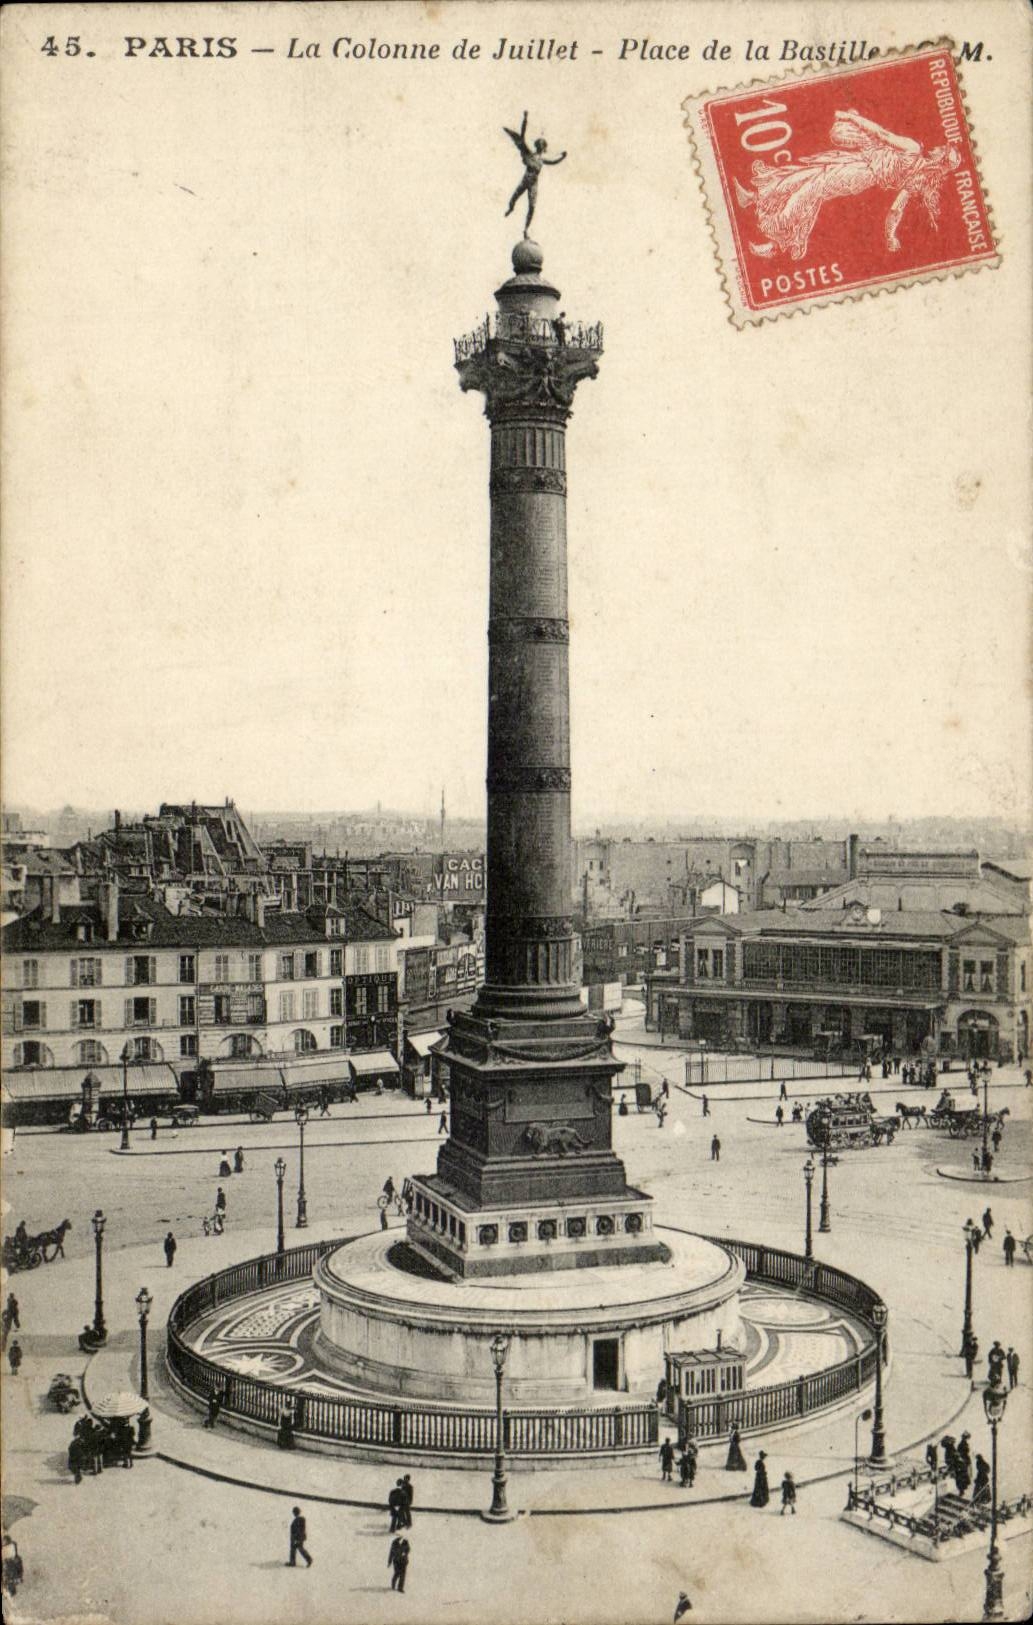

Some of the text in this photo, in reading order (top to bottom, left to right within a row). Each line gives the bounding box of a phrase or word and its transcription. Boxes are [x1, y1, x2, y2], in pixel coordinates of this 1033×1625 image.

[955, 170, 988, 252] FRANÇAISE
[761, 263, 844, 297] POSTES
[434, 873, 459, 889] VAN
[347, 973, 396, 985] OPTIQUE
